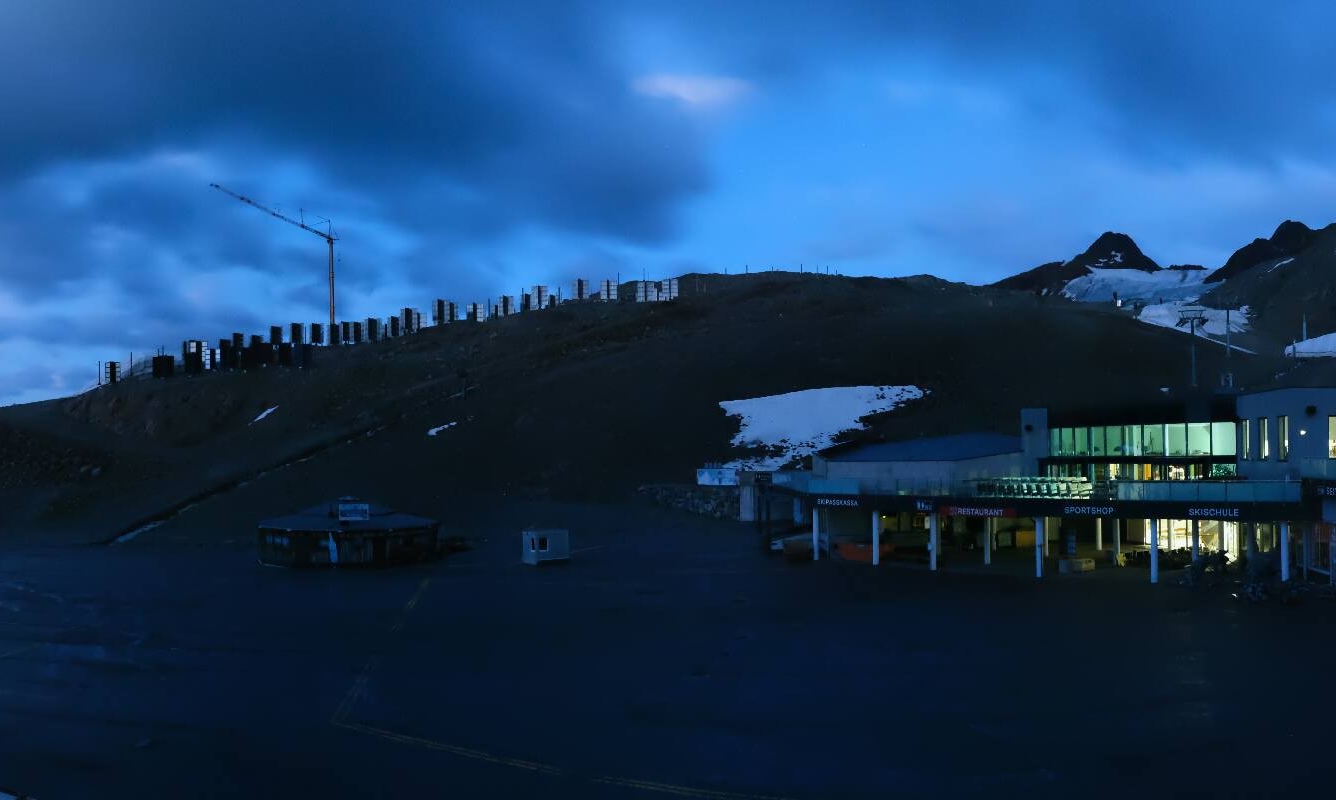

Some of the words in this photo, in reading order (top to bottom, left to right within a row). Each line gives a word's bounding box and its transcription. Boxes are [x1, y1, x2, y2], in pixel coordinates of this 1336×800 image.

[816, 498, 859, 507] SKIPASSKASSA
[957, 507, 1005, 517] RESTAURANT
[1063, 506, 1114, 516] SPORTSHOP
[1188, 508, 1239, 517] SKISCHULE
